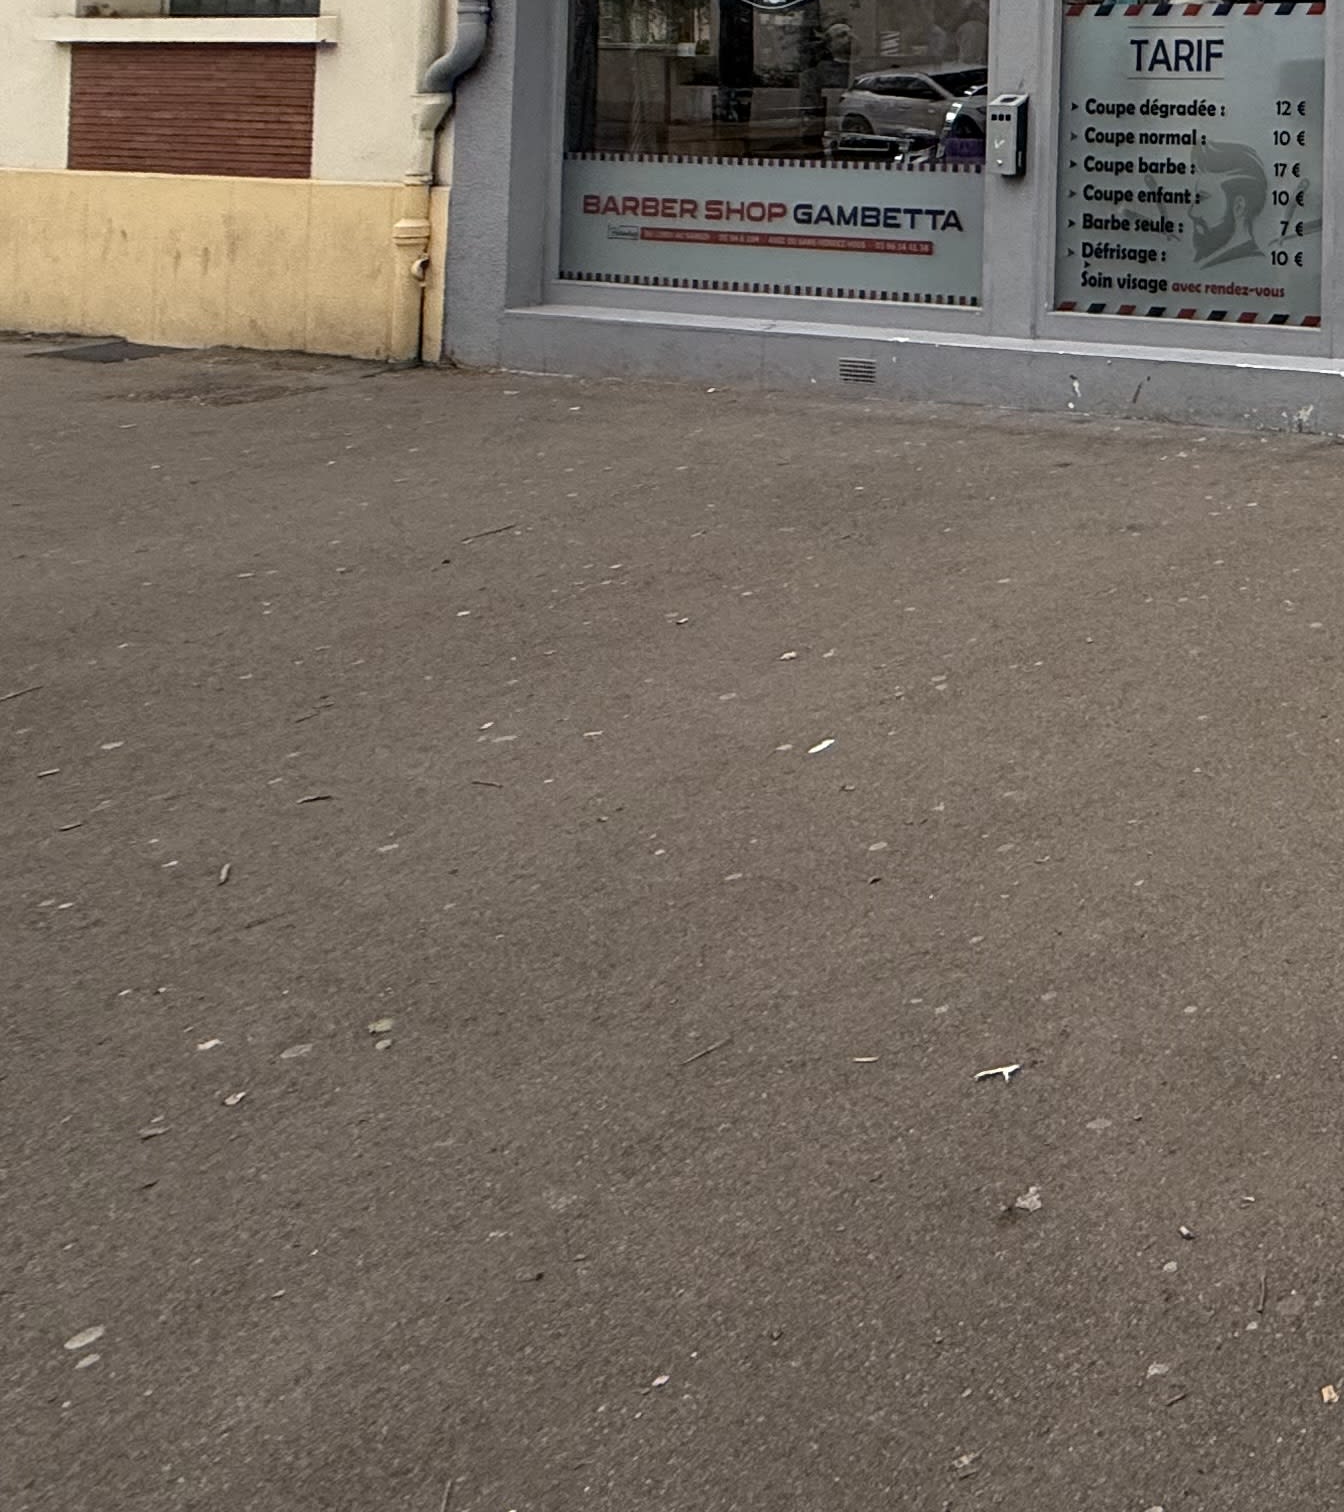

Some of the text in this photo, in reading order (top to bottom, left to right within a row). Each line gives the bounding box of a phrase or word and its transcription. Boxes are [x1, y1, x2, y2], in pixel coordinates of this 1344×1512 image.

[1130, 39, 1225, 72] TARIF
[1085, 98, 1136, 118] Coupe
[1139, 99, 1217, 118] dégradée
[1276, 100, 1291, 116] 12
[1297, 101, 1306, 116] €
[1084, 127, 1135, 147] Coupe
[1139, 129, 1197, 145] normal
[1273, 130, 1291, 146] 10
[1296, 131, 1305, 146] €
[1084, 155, 1134, 176] Coupe
[1138, 156, 1187, 175] barbe
[1273, 163, 1288, 178] 17
[1292, 163, 1300, 178] €
[1083, 184, 1134, 205] Coupe
[1137, 186, 1191, 204] enfant
[1272, 190, 1289, 206] 10
[1295, 191, 1304, 206] €
[583, 194, 964, 232] BARBER SHOP GAMBETTA
[1082, 213, 1130, 230] Barbe
[1134, 216, 1174, 233] seule
[1280, 221, 1288, 236] 7
[1295, 222, 1303, 237] €
[1081, 242, 1157, 264] Défrisage
[1271, 251, 1288, 266] 10
[1294, 252, 1303, 267] €
[1081, 270, 1285, 297] Soin visage avec rendez-vous
